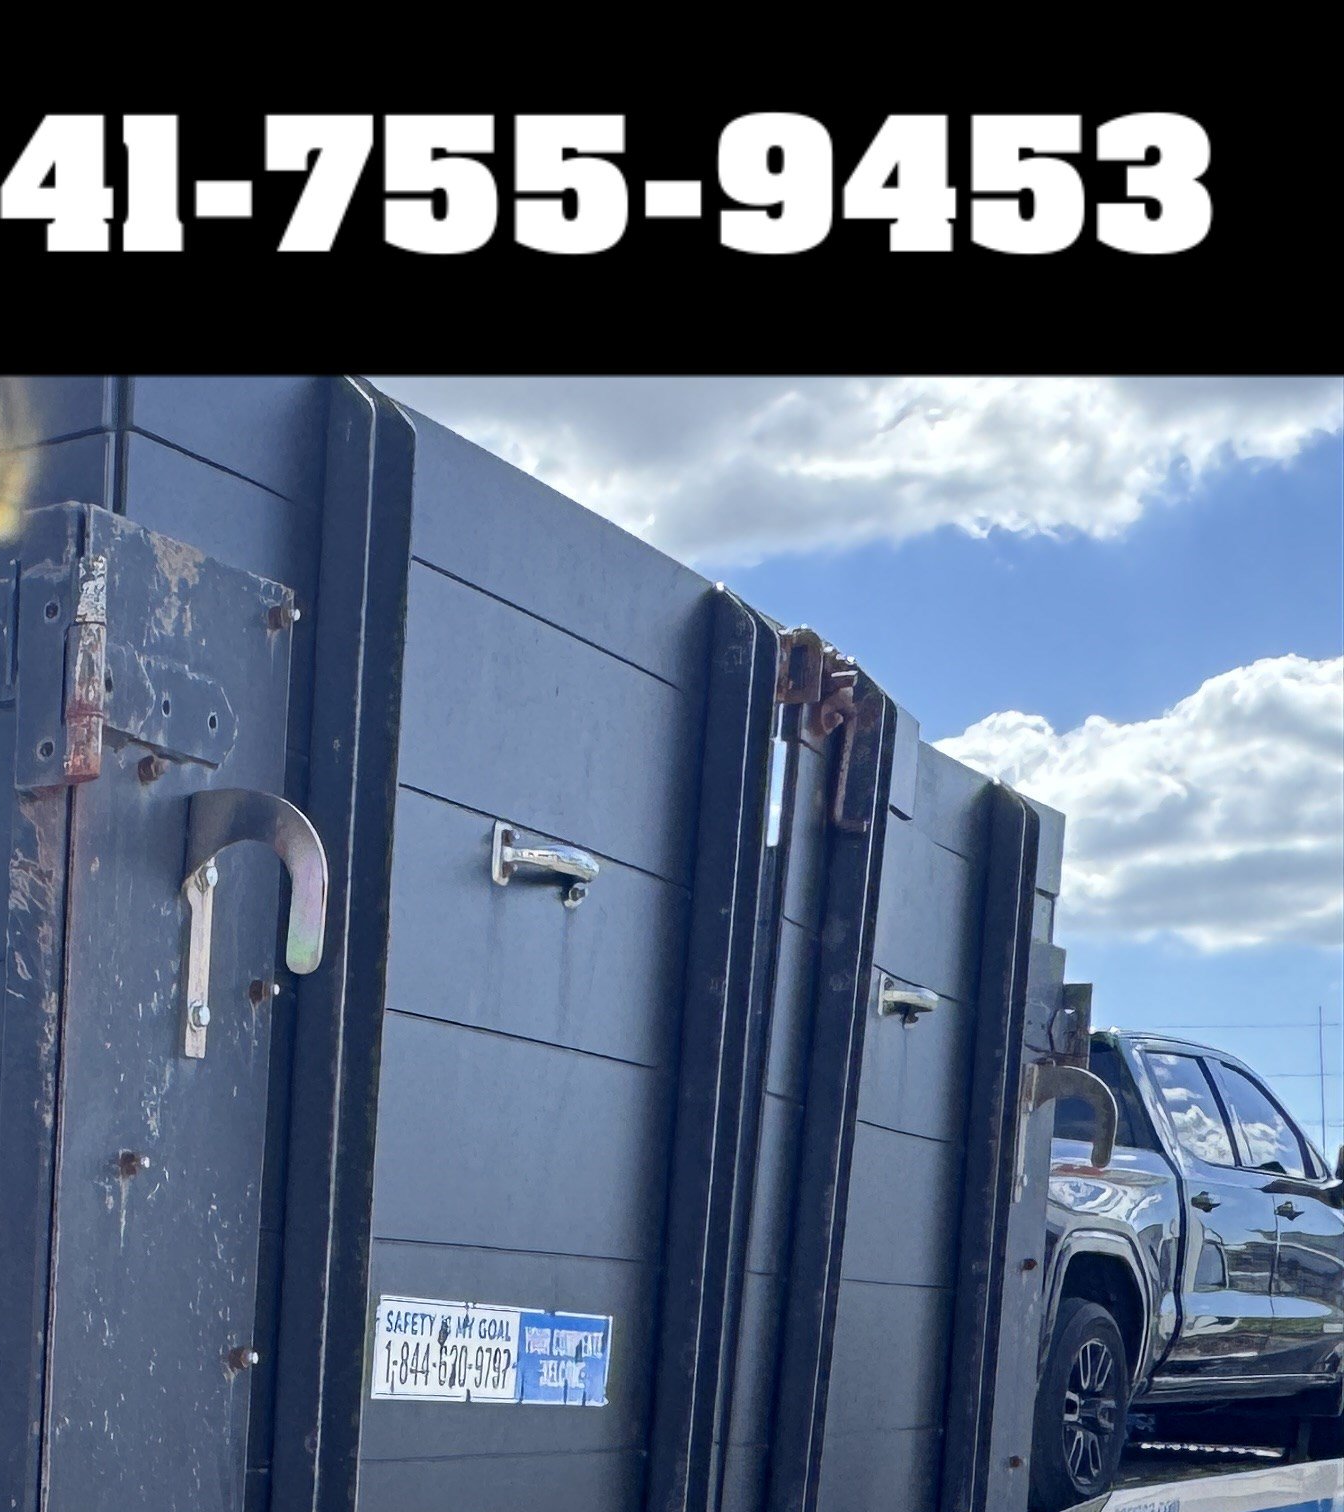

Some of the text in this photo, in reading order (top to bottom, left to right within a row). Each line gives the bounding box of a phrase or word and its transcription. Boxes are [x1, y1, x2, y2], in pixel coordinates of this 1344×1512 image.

[386, 1310, 436, 1336] SAFETY
[455, 1314, 475, 1339] MY
[478, 1319, 511, 1342] GOAL
